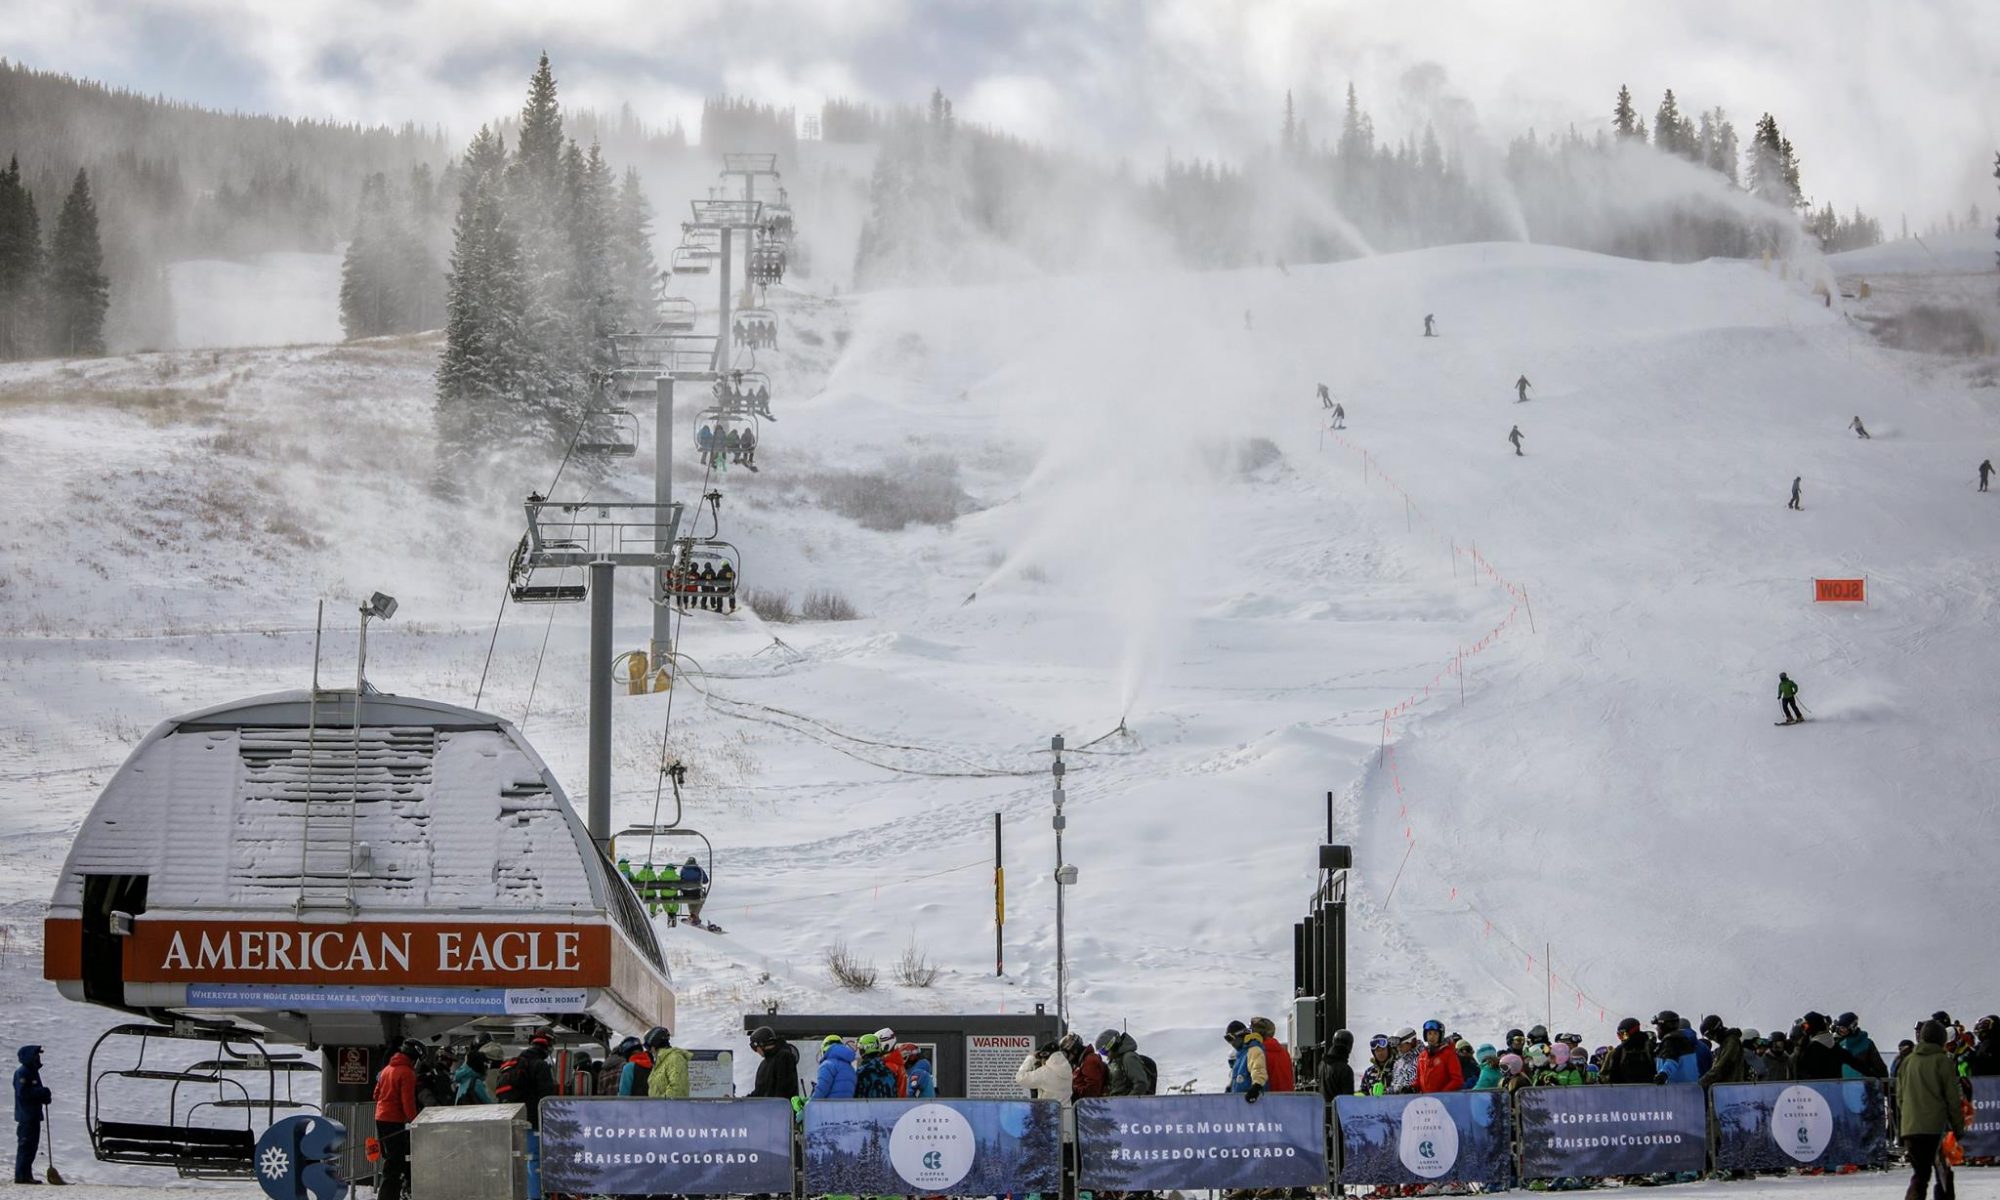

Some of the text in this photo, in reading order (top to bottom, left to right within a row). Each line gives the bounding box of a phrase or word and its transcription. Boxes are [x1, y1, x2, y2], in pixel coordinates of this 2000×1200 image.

[161, 930, 580, 972] AMERICAN EAGLE
[289, 993, 325, 1001] ADDRESS
[414, 995, 443, 1004] RAISED
[445, 996, 457, 1004] ON
[972, 1037, 1030, 1048] WARNING
